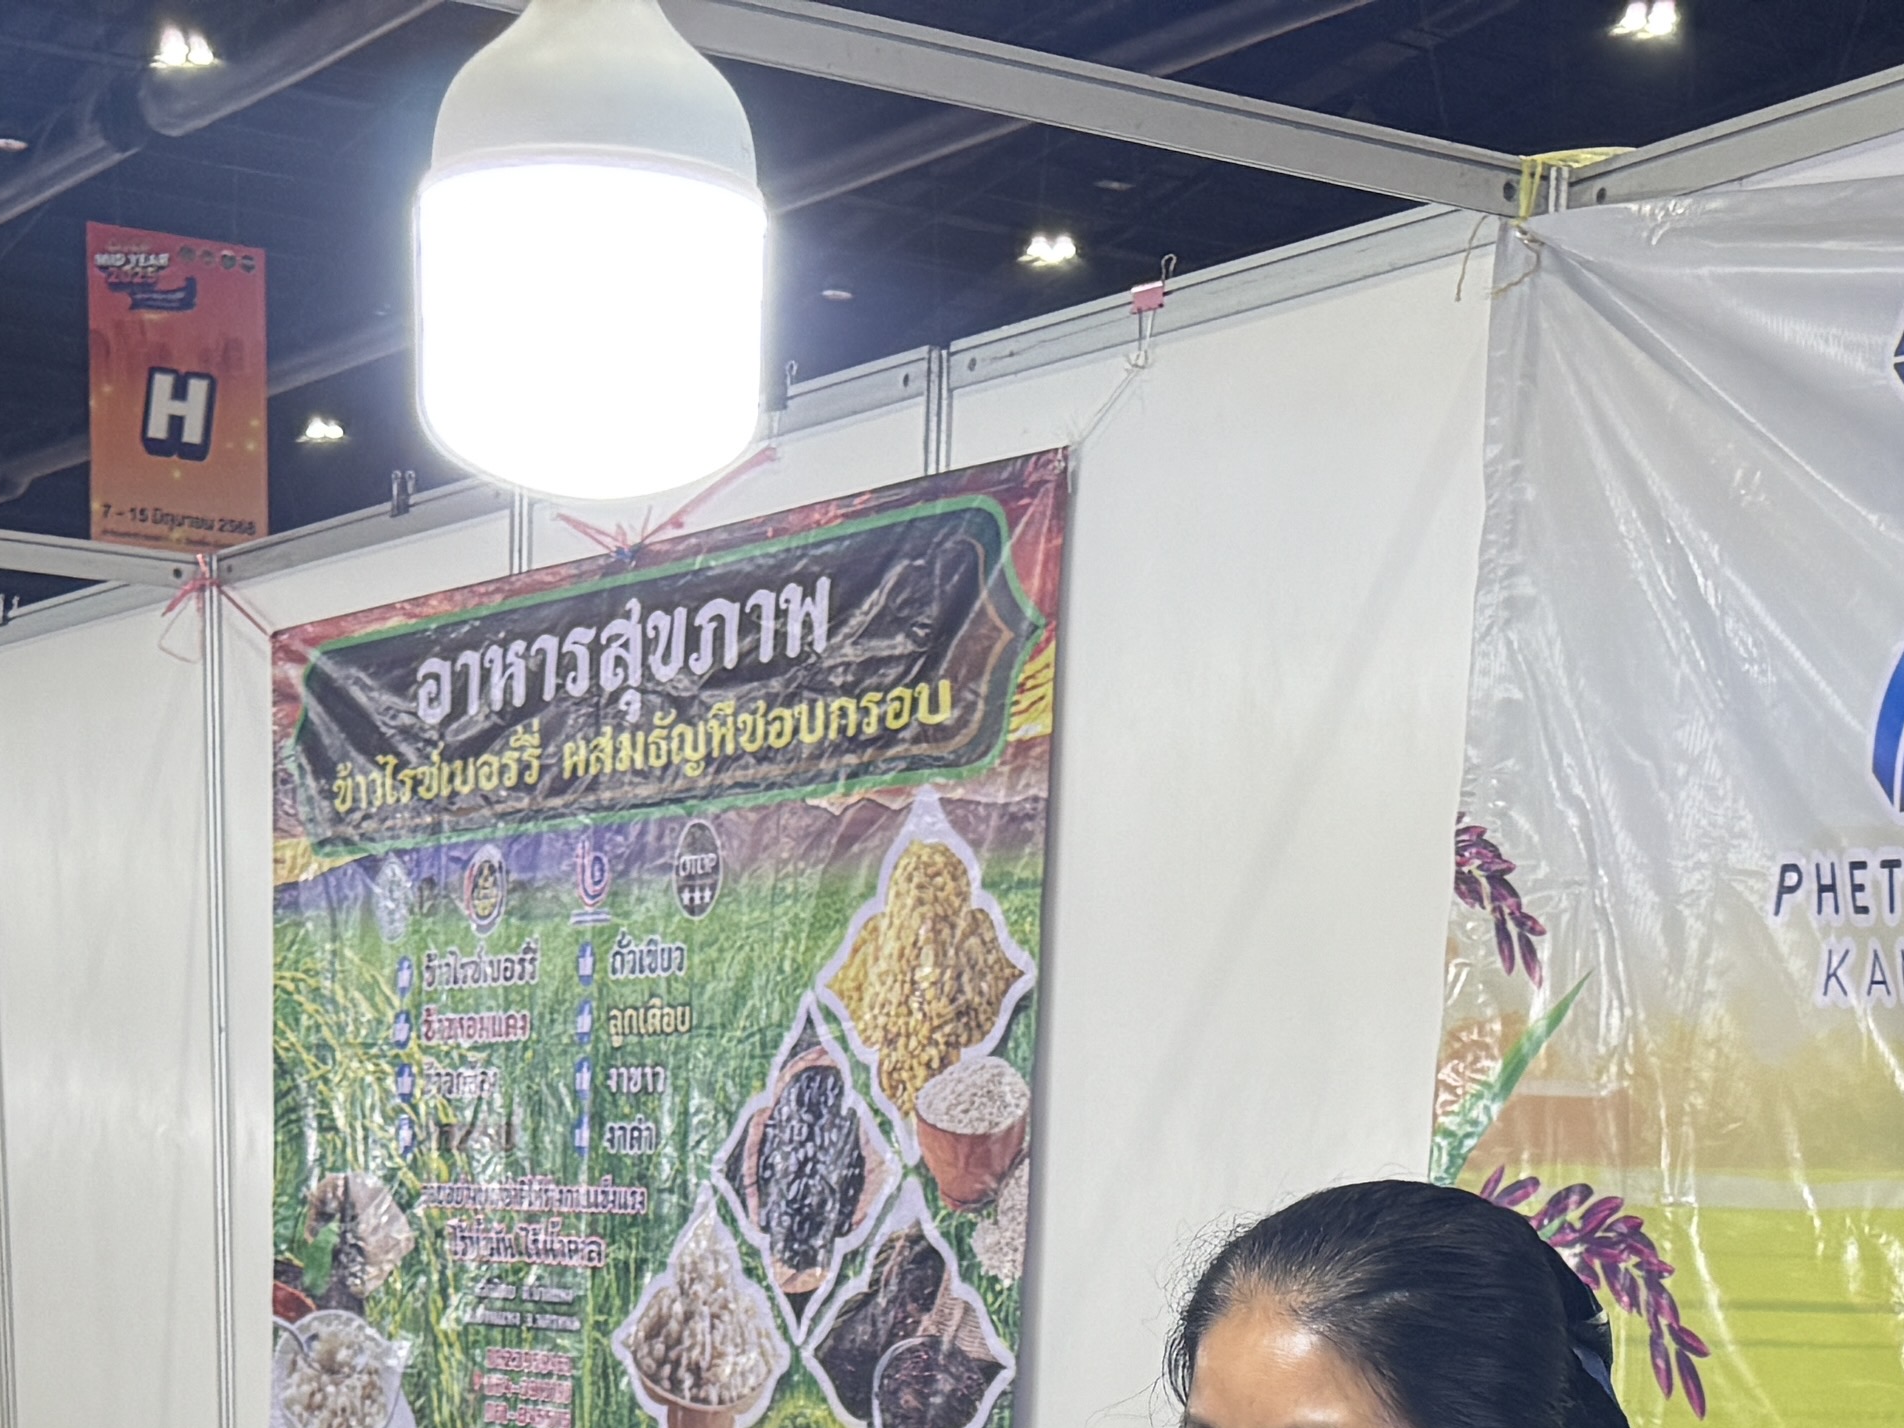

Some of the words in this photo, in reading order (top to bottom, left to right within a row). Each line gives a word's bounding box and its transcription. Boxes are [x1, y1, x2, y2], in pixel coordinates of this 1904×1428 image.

[143, 366, 216, 462] H
[414, 577, 834, 722] อาหารสุขภาพ
